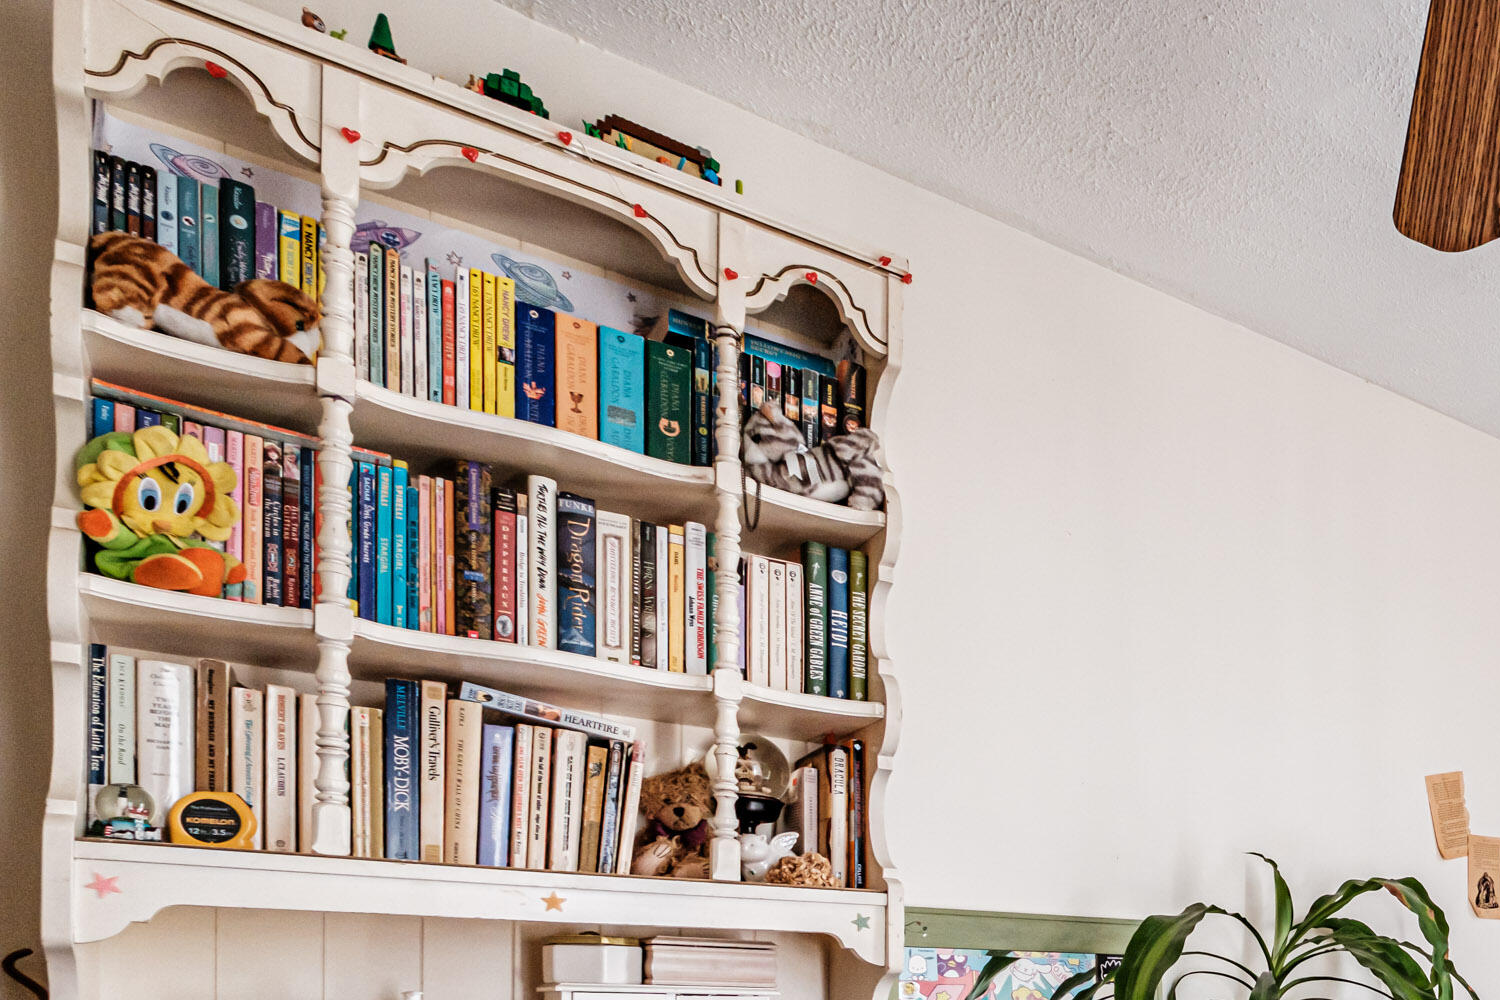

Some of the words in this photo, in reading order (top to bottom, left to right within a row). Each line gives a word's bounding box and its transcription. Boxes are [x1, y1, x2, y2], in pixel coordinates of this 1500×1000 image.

[304, 231, 314, 262] NANCY
[372, 292, 380, 318] MYSTERY
[502, 290, 510, 318] NANCY
[502, 318, 510, 341] DREW
[363, 477, 371, 501] SACHAR
[381, 472, 389, 507] SPINELLI
[536, 484, 549, 513] TURTLES
[273, 501, 281, 527] Circles
[395, 485, 404, 520] SPINELLI
[559, 499, 595, 514] FUNKE
[363, 522, 372, 539] Grade
[536, 515, 549, 528] ALL
[536, 531, 549, 546] THE
[567, 518, 591, 584] Dragon
[363, 541, 372, 563] Secrets
[380, 537, 388, 574] STARGIRL
[395, 534, 404, 571] STARGIRL
[536, 547, 549, 566] WAY
[536, 567, 549, 590] DOWN
[697, 568, 705, 580] THE
[697, 581, 705, 601] SWISS
[809, 583, 824, 608] ANNE
[852, 591, 866, 609] THE
[536, 593, 549, 616] JOHN
[567, 587, 591, 633] Rider
[697, 602, 705, 625] FAMILY
[809, 608, 824, 618] of
[536, 619, 549, 648] GREEN
[809, 618, 824, 647] GREEN
[831, 609, 848, 649] HEIDI
[852, 609, 866, 643] SECRET
[697, 626, 705, 659] ROBINSON
[92, 657, 105, 672] The
[809, 647, 824, 680] GABLES
[852, 643, 866, 679] GARDEN
[92, 674, 105, 714] Education
[208, 700, 215, 709] MY
[277, 694, 286, 722] ROBERT
[396, 685, 406, 730] MELVILLE
[92, 716, 105, 727] of
[118, 723, 127, 734] On
[428, 705, 442, 749] Gulliver's
[563, 714, 620, 735] HEARTFIRE
[92, 728, 105, 751] Little
[118, 735, 127, 746] the
[277, 723, 286, 750] GRAVES
[92, 753, 105, 771] Tree
[118, 747, 127, 765] Road
[208, 758, 215, 769] MY
[428, 749, 442, 781] Travels
[393, 735, 410, 812] MOBY-DICK
[834, 757, 844, 795] DRACULA
[456, 797, 461, 806] OF
